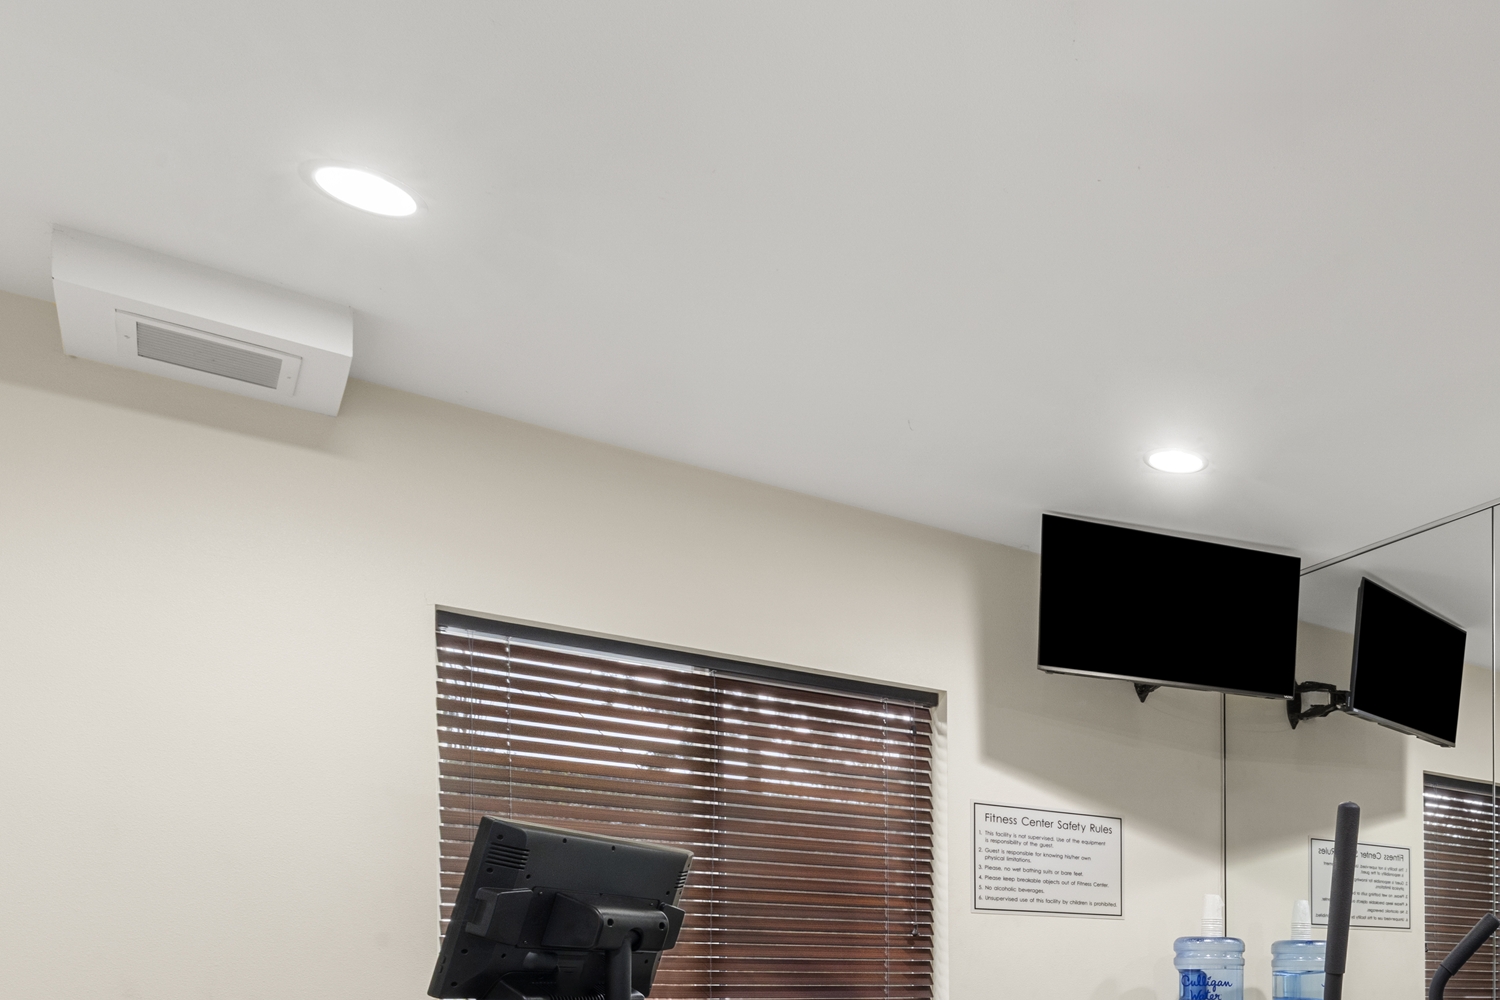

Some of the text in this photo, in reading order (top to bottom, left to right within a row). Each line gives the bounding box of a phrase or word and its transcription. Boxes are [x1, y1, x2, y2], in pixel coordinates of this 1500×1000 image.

[984, 812, 1113, 834] Fitness Center Safety Rules
[990, 838, 1022, 846] responsibility
[1181, 974, 1232, 992] Culligan
[1190, 989, 1222, 1000] Water
